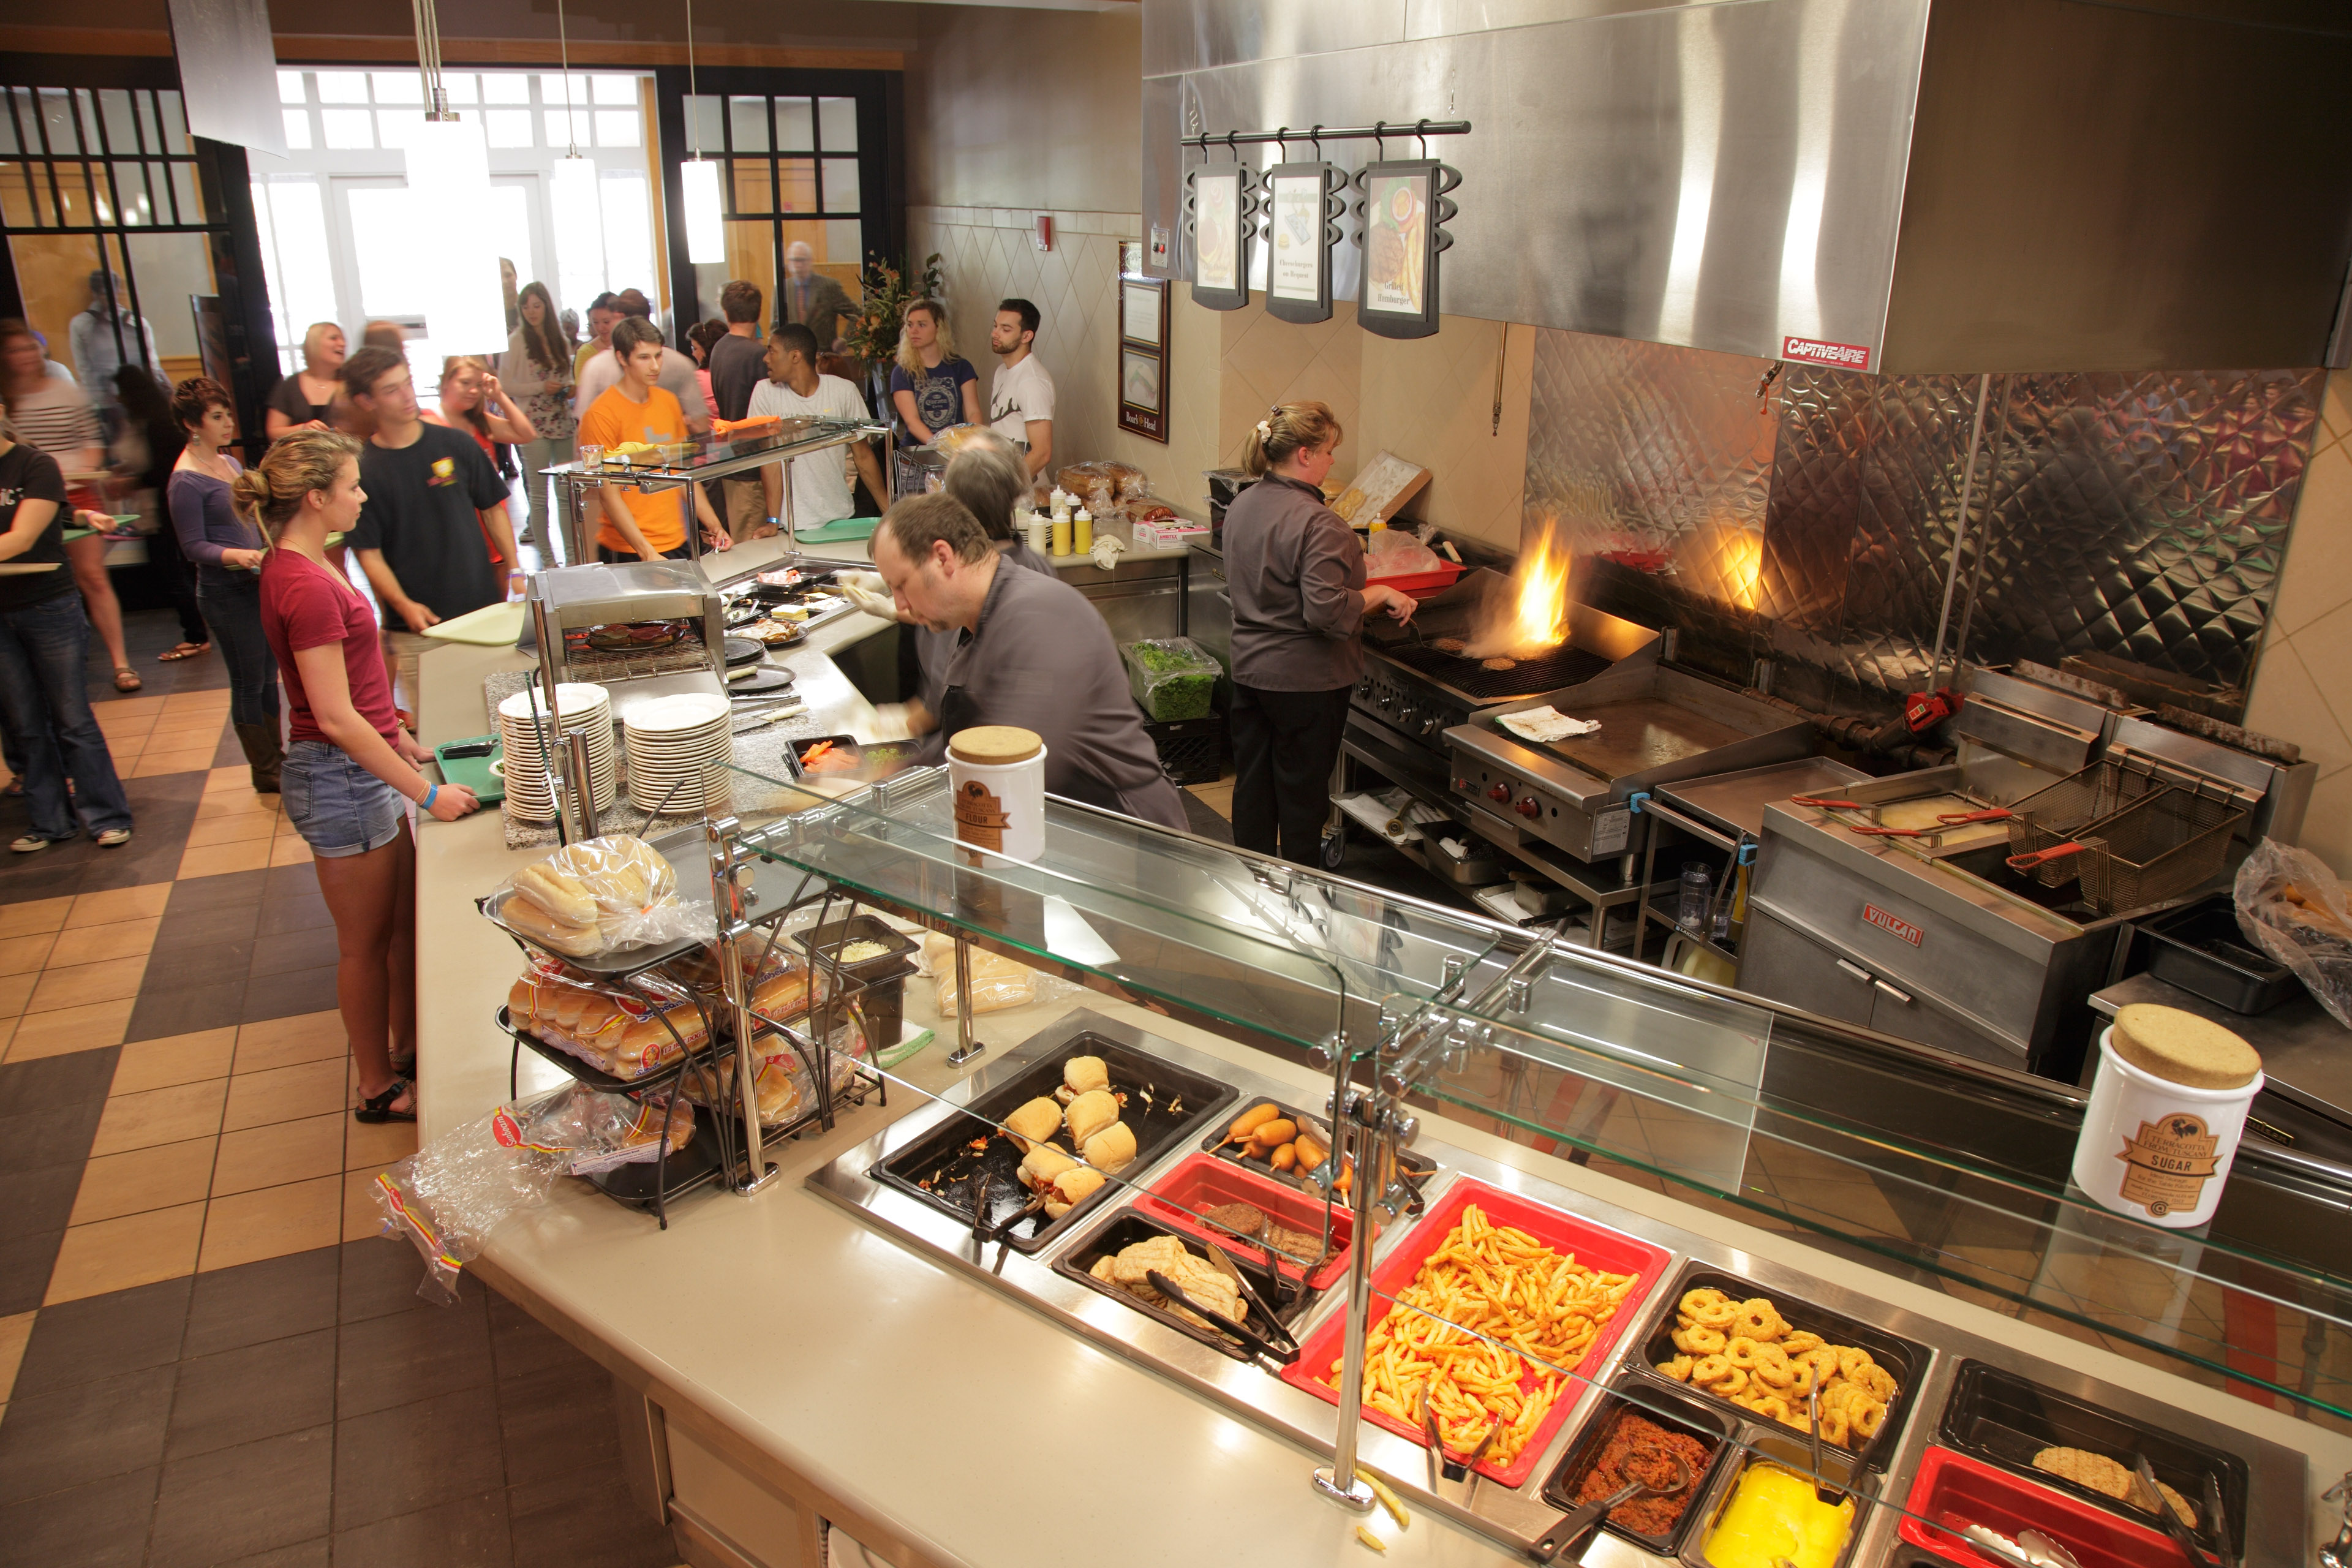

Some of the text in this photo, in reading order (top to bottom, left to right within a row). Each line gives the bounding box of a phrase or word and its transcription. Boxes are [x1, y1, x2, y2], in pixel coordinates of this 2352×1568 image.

[1280, 259, 1313, 269] Cheeseburgers
[1290, 270, 1309, 279] Request
[1384, 282, 1404, 291] Grilled
[1378, 293, 1410, 306] Hamburger
[1126, 411, 1156, 431] Boar's Head
[966, 813, 988, 824] FLOUR
[1869, 907, 1917, 942] VULCAN
[687, 1031, 701, 1042] DOG
[497, 1116, 517, 1147] Sunbeam
[2144, 1140, 2207, 1158] FROM TUSCANY
[2151, 1136, 2206, 1151] TERRACOTTA
[2151, 1155, 2192, 1171] SUGAR
